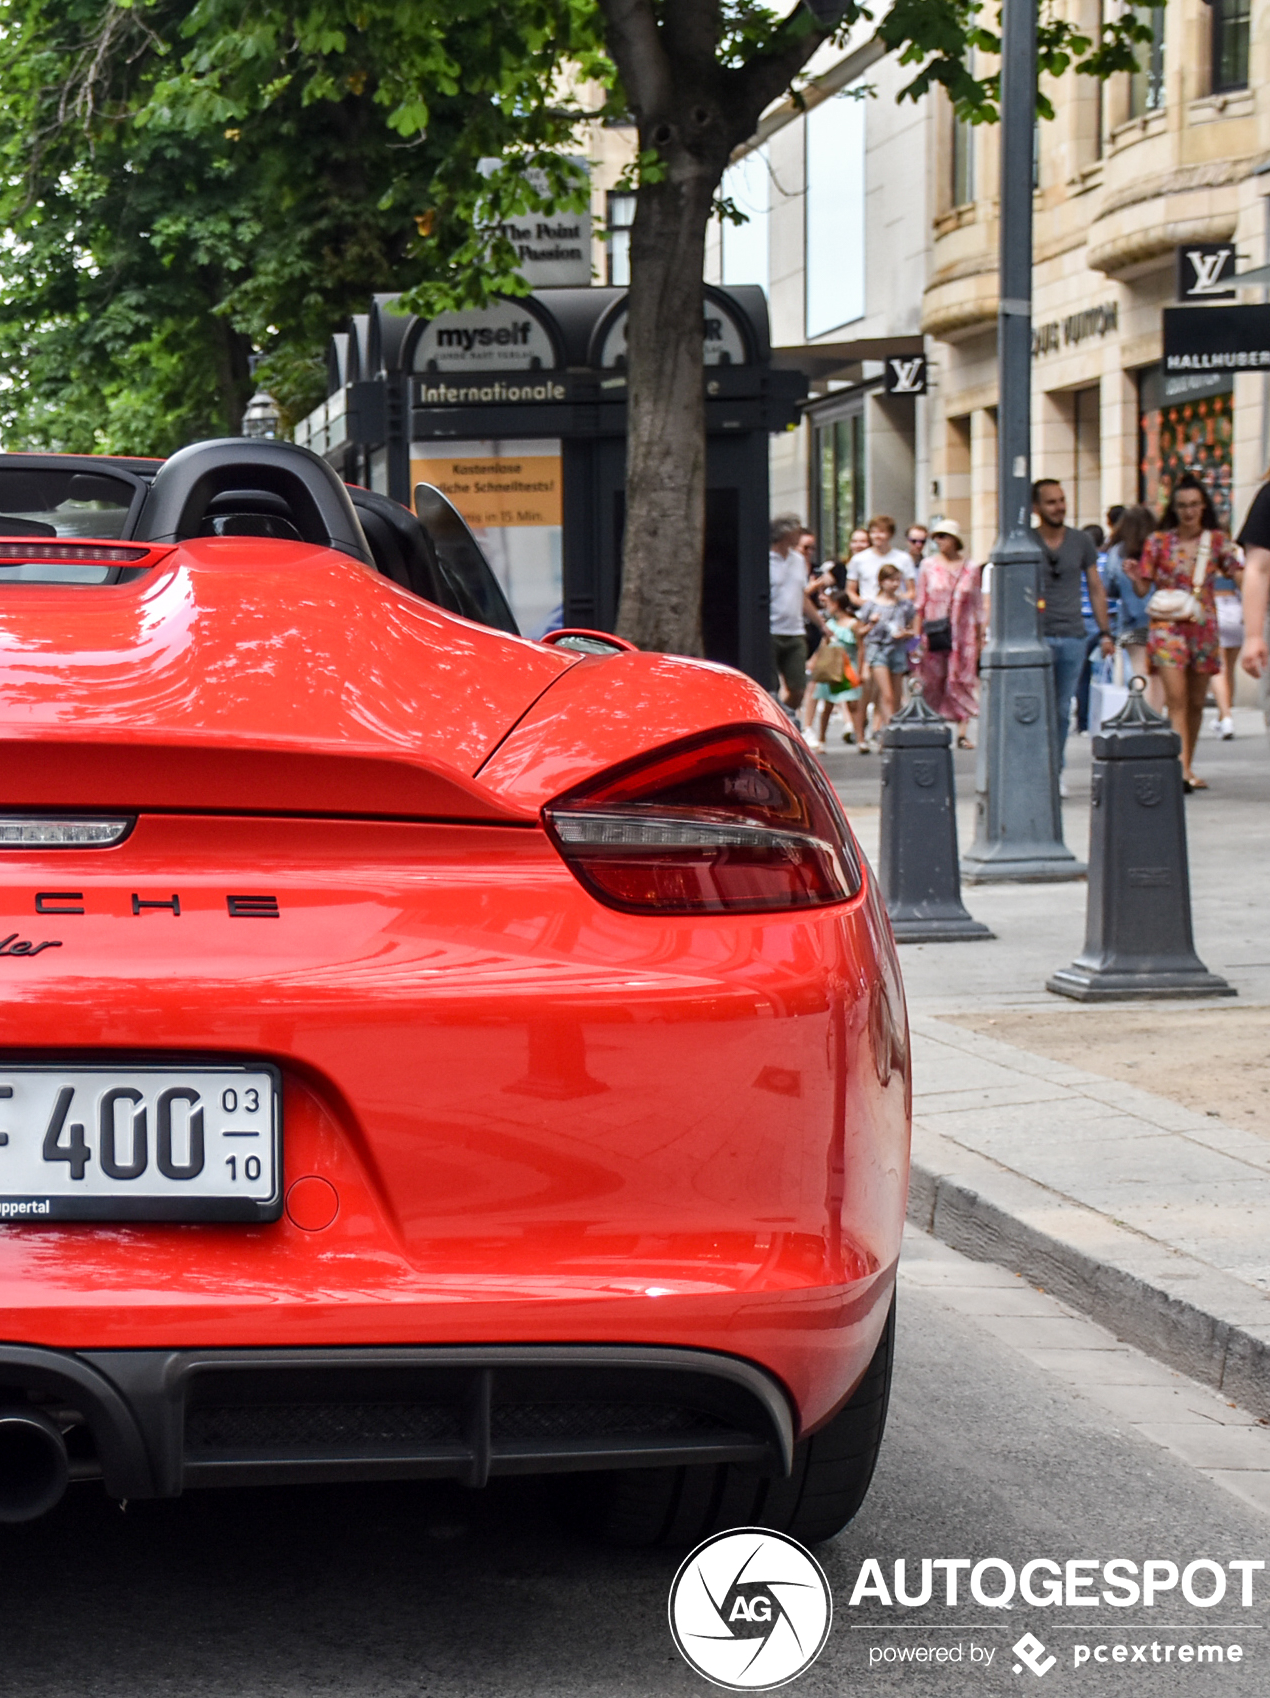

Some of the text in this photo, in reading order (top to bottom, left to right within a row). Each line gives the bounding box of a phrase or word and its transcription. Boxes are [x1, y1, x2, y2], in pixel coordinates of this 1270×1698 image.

[501, 223, 580, 239] The Point
[518, 245, 581, 260] Passion
[437, 320, 532, 351] myself
[1167, 350, 1270, 370] HALLHUBER
[421, 381, 565, 402] Internationale
[452, 463, 522, 475] Kostenlose
[473, 480, 554, 494] Schnelltests!
[221, 1088, 260, 1114] 03
[42, 1086, 206, 1181] 400
[224, 1155, 262, 1181] 10
